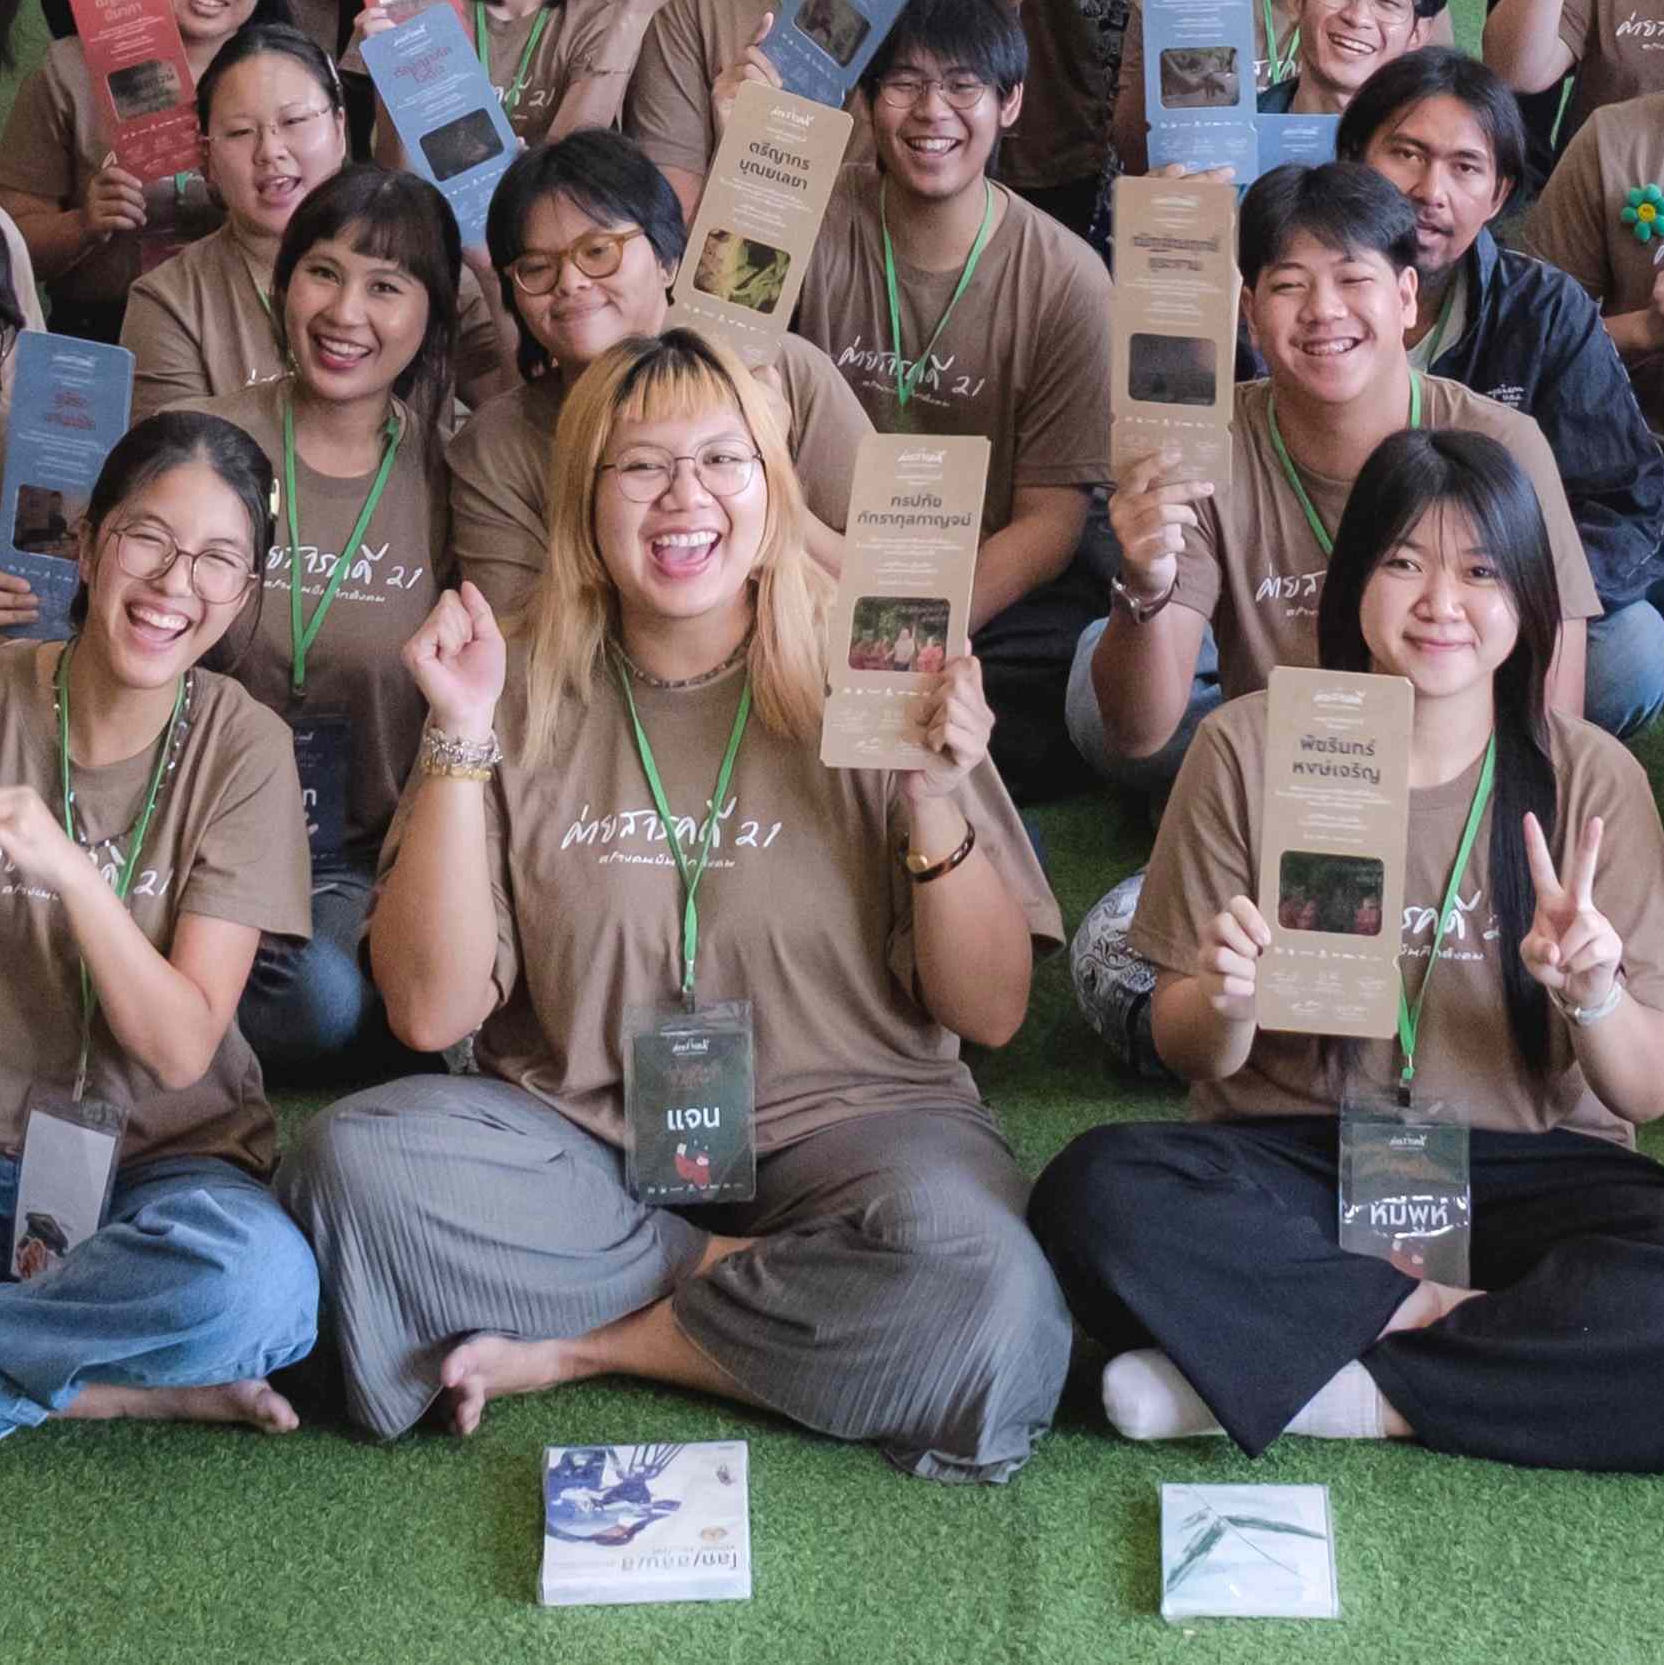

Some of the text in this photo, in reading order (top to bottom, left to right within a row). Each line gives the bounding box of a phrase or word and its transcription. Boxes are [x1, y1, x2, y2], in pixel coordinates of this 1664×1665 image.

[529, 85, 556, 110] 21
[956, 375, 986, 398] 21
[389, 564, 423, 589] 21
[738, 819, 782, 849] 21
[132, 863, 171, 896] 21
[667, 1106, 721, 1132] แจน
